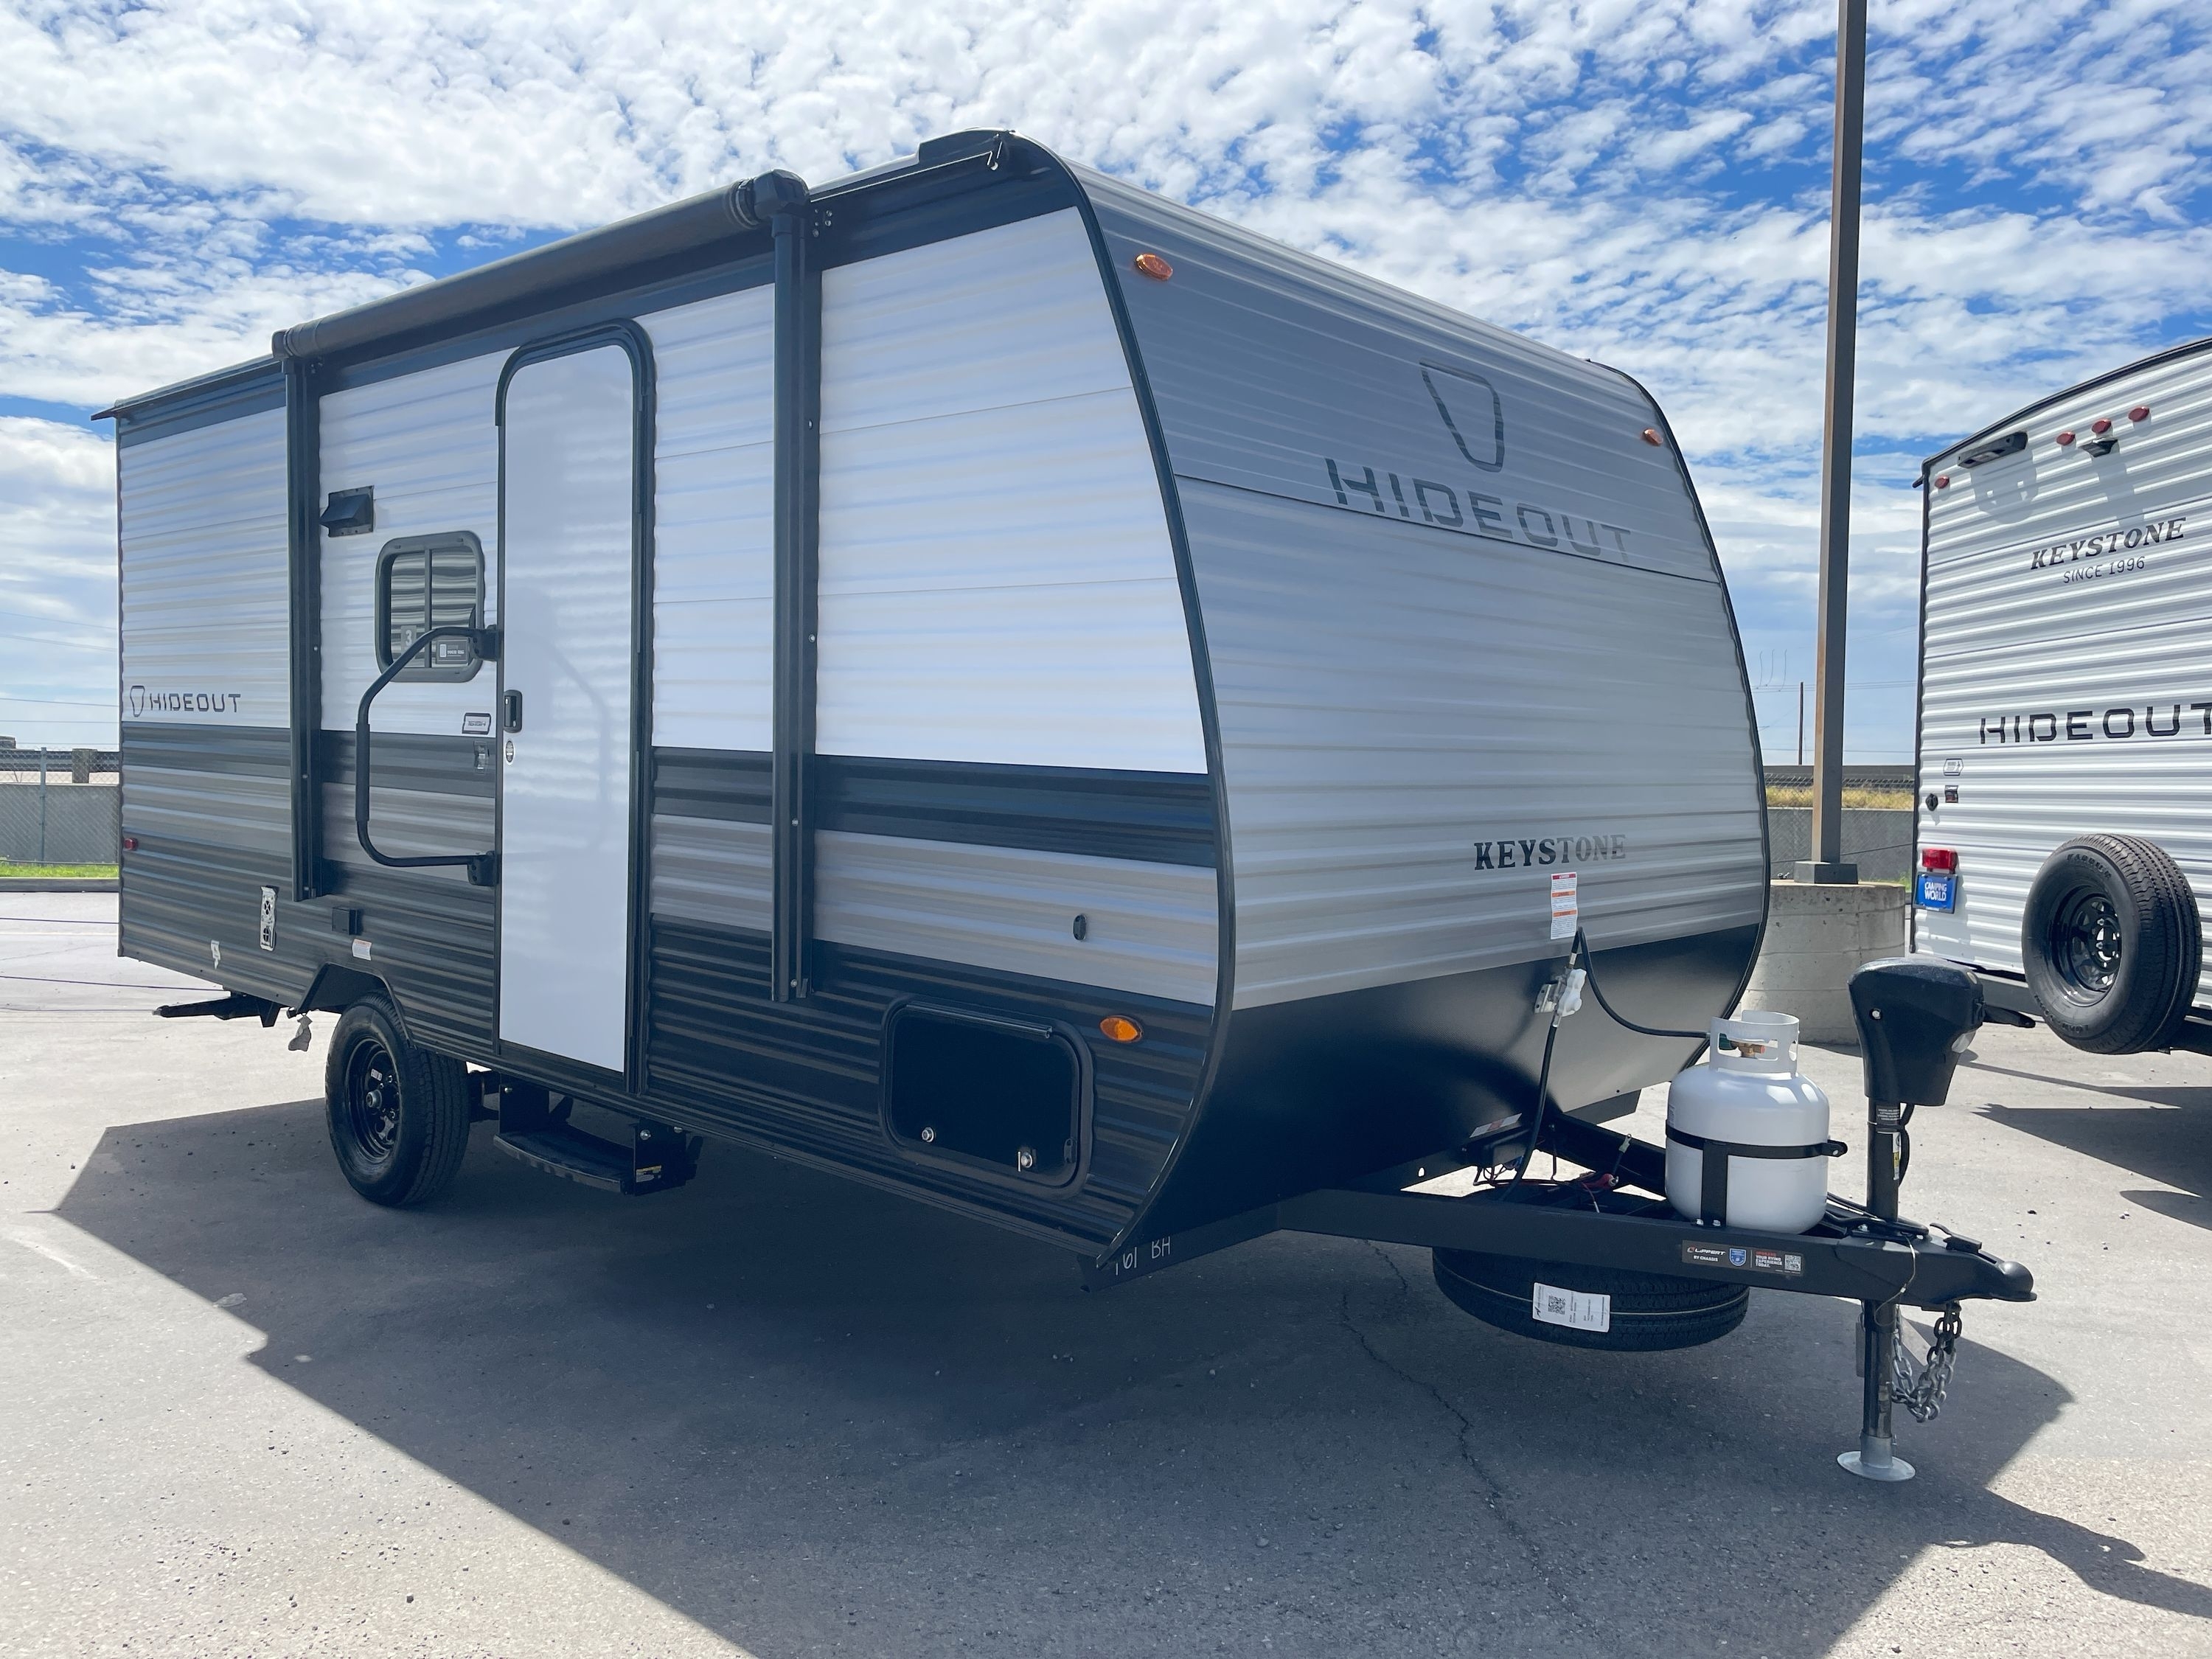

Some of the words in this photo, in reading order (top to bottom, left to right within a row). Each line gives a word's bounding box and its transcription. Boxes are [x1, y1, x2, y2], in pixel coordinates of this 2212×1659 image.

[1325, 458, 1631, 563] HIDEOUT
[2031, 517, 2186, 570] KEYSTONE
[2064, 565, 2103, 583] SINCE
[2109, 556, 2146, 574] 1996
[150, 693, 241, 713] HIDEOUT
[1980, 703, 2212, 744] HIDEOUT
[1474, 834, 1627, 871] KEYSTONE
[1924, 881, 1947, 892] CAMPING
[1924, 890, 1947, 901] WORLD
[1152, 1236, 1170, 1259] BH
